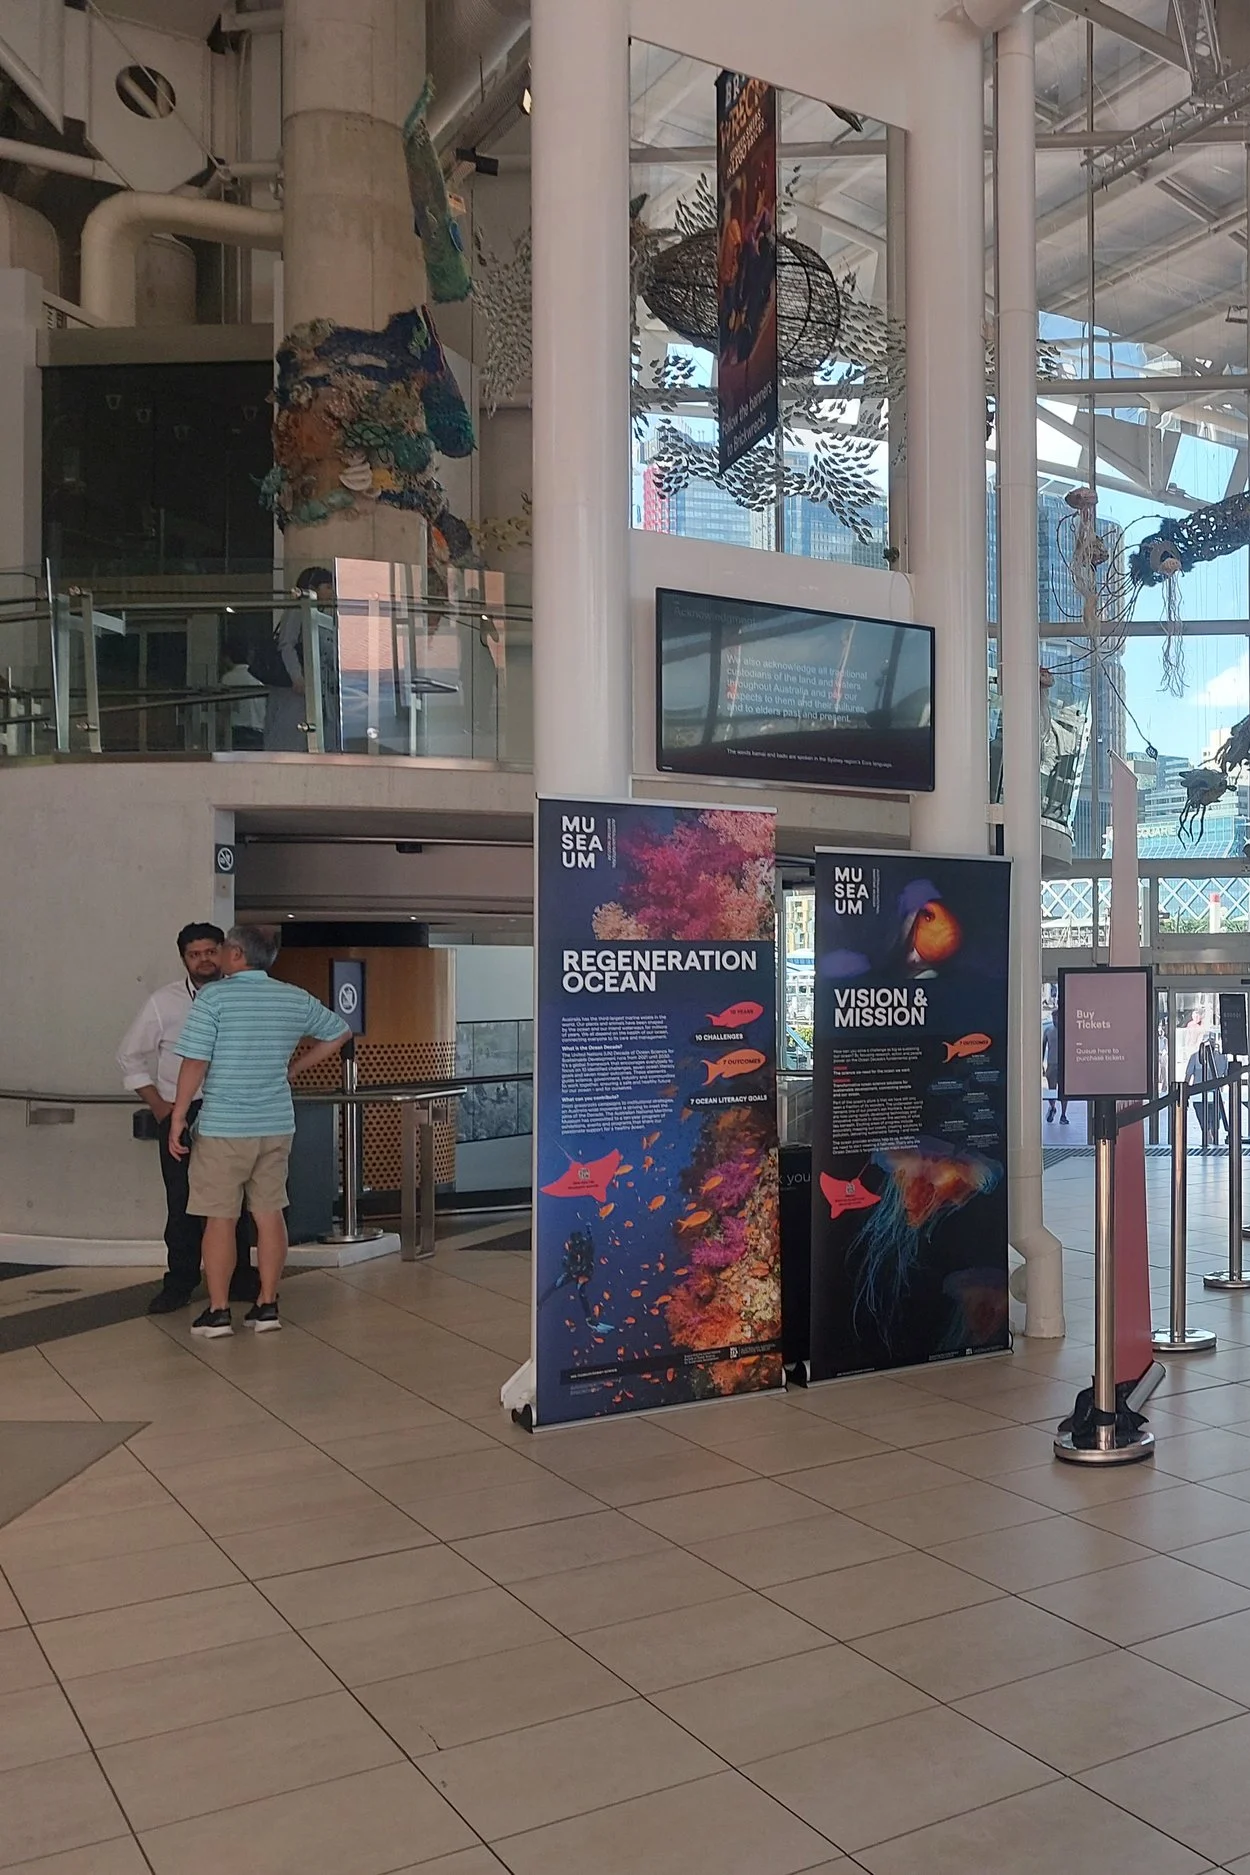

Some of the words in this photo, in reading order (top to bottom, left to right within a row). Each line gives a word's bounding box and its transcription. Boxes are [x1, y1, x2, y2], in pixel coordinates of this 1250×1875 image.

[721, 412, 739, 438] Follow
[739, 403, 749, 422] the
[749, 381, 772, 412] banners
[727, 443, 733, 457] to
[727, 668, 771, 680] custodians
[773, 672, 782, 681] of
[784, 673, 797, 683] the
[798, 675, 816, 686] land
[818, 678, 833, 687] and
[743, 657, 761, 666] also
[763, 660, 816, 674] acknowledge
[818, 667, 828, 676] all
[829, 668, 868, 680] trational
[727, 679, 772, 693] throughout
[773, 684, 808, 697] Australia
[811, 687, 826, 698] and
[844, 692, 858, 701] our
[727, 692, 763, 703] respects
[765, 694, 774, 703] to
[775, 696, 796, 706] them
[799, 698, 813, 708] and
[815, 700, 832, 710] their
[727, 702, 743, 712] and
[745, 704, 754, 713] to
[755, 705, 781, 716] elders
[783, 708, 800, 719] past
[802, 710, 818, 720] and
[820, 712, 851, 723] present.
[562, 815, 595, 833] MU
[561, 833, 604, 852] SEA
[562, 851, 595, 869] UM
[835, 866, 863, 882] MU
[834, 883, 869, 899] SEA
[835, 899, 863, 915] UM
[563, 950, 757, 972] REGENERATION
[562, 971, 656, 993] OCEAN
[833, 988, 908, 1008] VISION
[913, 988, 928, 1007] &
[834, 1007, 925, 1028] MISSION
[1076, 1009, 1095, 1020] Buy
[1076, 1020, 1111, 1029] Tickets
[703, 1033, 743, 1041] CHALLENGES
[695, 1097, 718, 1105] OCEAN
[719, 1096, 748, 1104] LITERACY
[748, 1094, 768, 1102] GOALS
[786, 1173, 811, 1186] you
